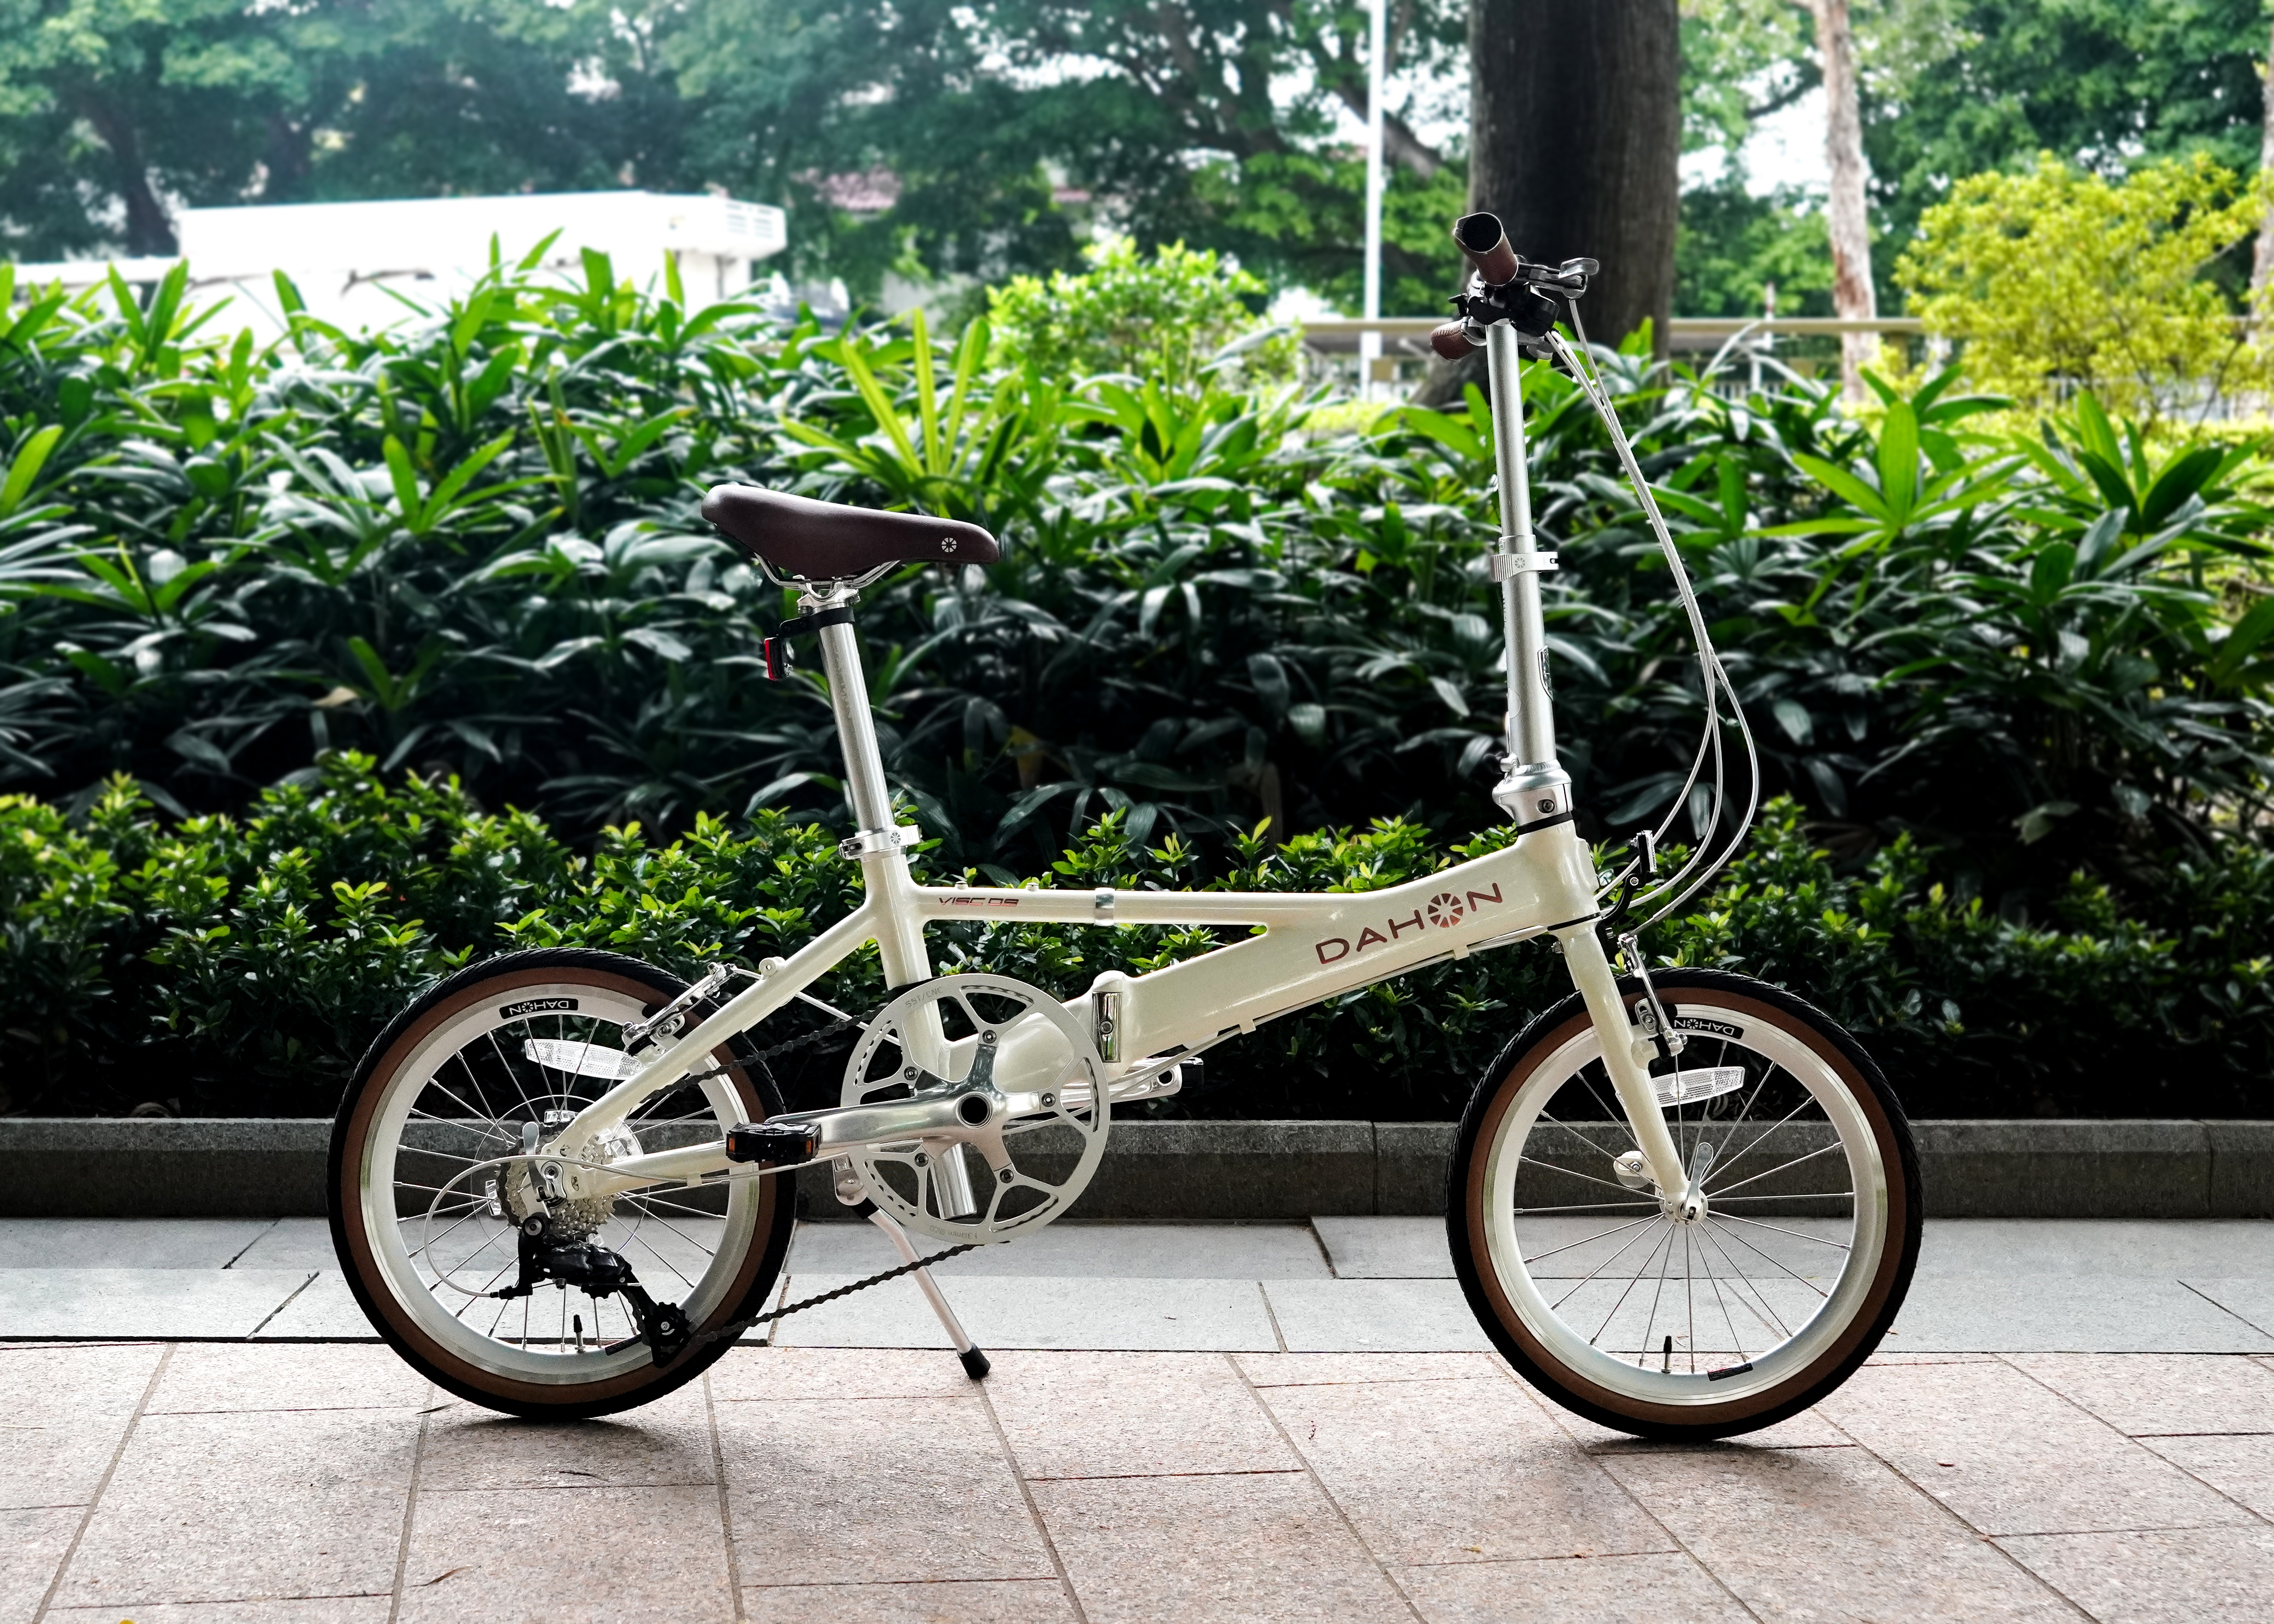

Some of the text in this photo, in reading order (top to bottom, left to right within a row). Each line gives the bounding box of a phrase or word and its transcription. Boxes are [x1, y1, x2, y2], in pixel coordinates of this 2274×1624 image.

[1316, 883, 1502, 964] DAHON
[509, 1000, 569, 1015] DAHON
[1674, 1018, 1735, 1035] DAHON
